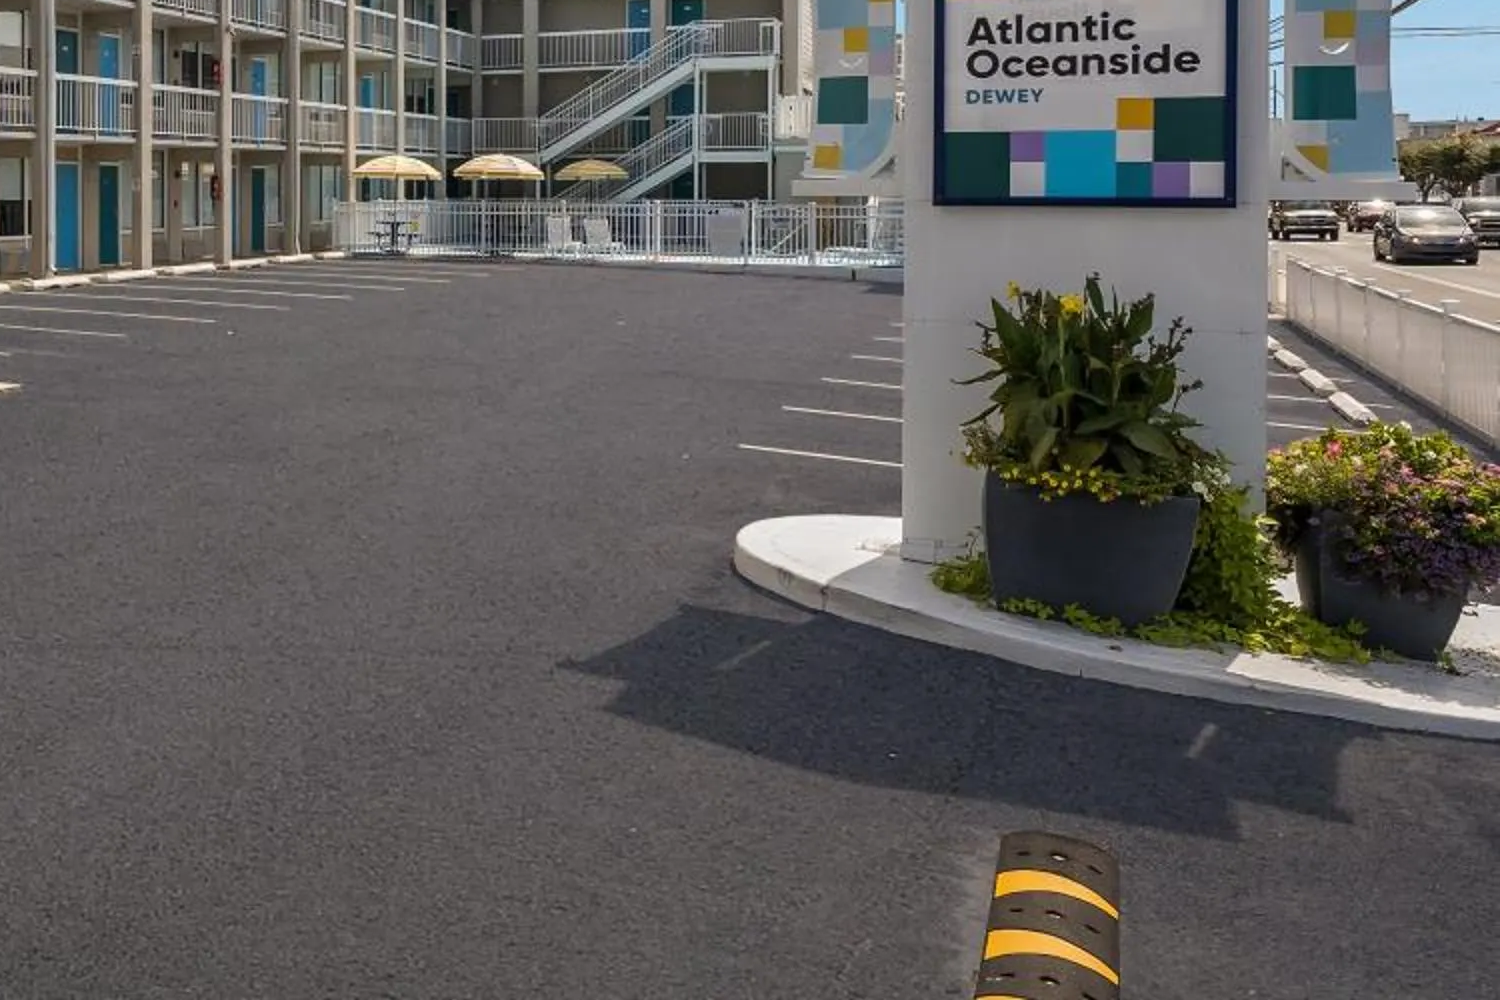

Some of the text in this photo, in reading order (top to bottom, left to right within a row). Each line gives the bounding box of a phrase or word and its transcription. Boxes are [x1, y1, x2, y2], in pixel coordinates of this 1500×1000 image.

[966, 11, 1136, 46] Atlantic
[966, 44, 1201, 79] Oceanside
[965, 88, 1044, 105] DEWEY
